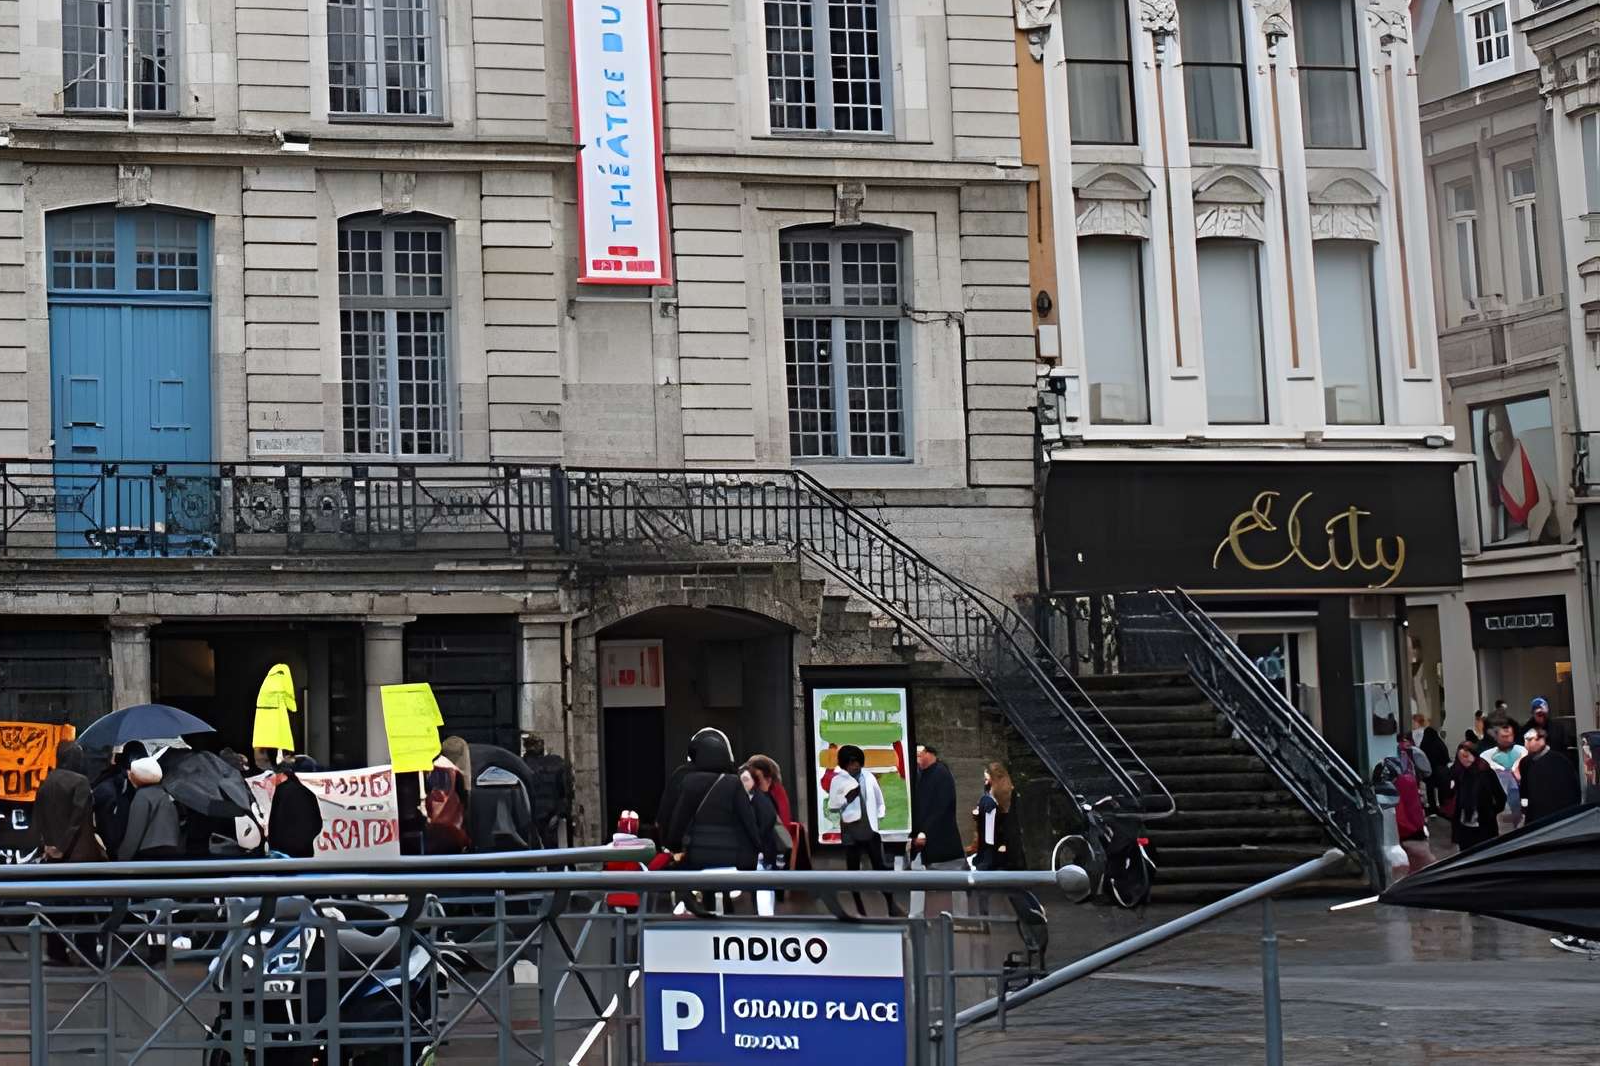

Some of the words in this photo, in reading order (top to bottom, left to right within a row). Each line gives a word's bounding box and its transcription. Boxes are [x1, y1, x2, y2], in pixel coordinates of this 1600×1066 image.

[601, 5, 624, 53] DU
[596, 69, 632, 233] THÉÂTRE
[713, 936, 828, 964] INDIGO
[661, 989, 704, 1051] P
[733, 998, 818, 1019] GRAND
[825, 1001, 899, 1022] PLACE
